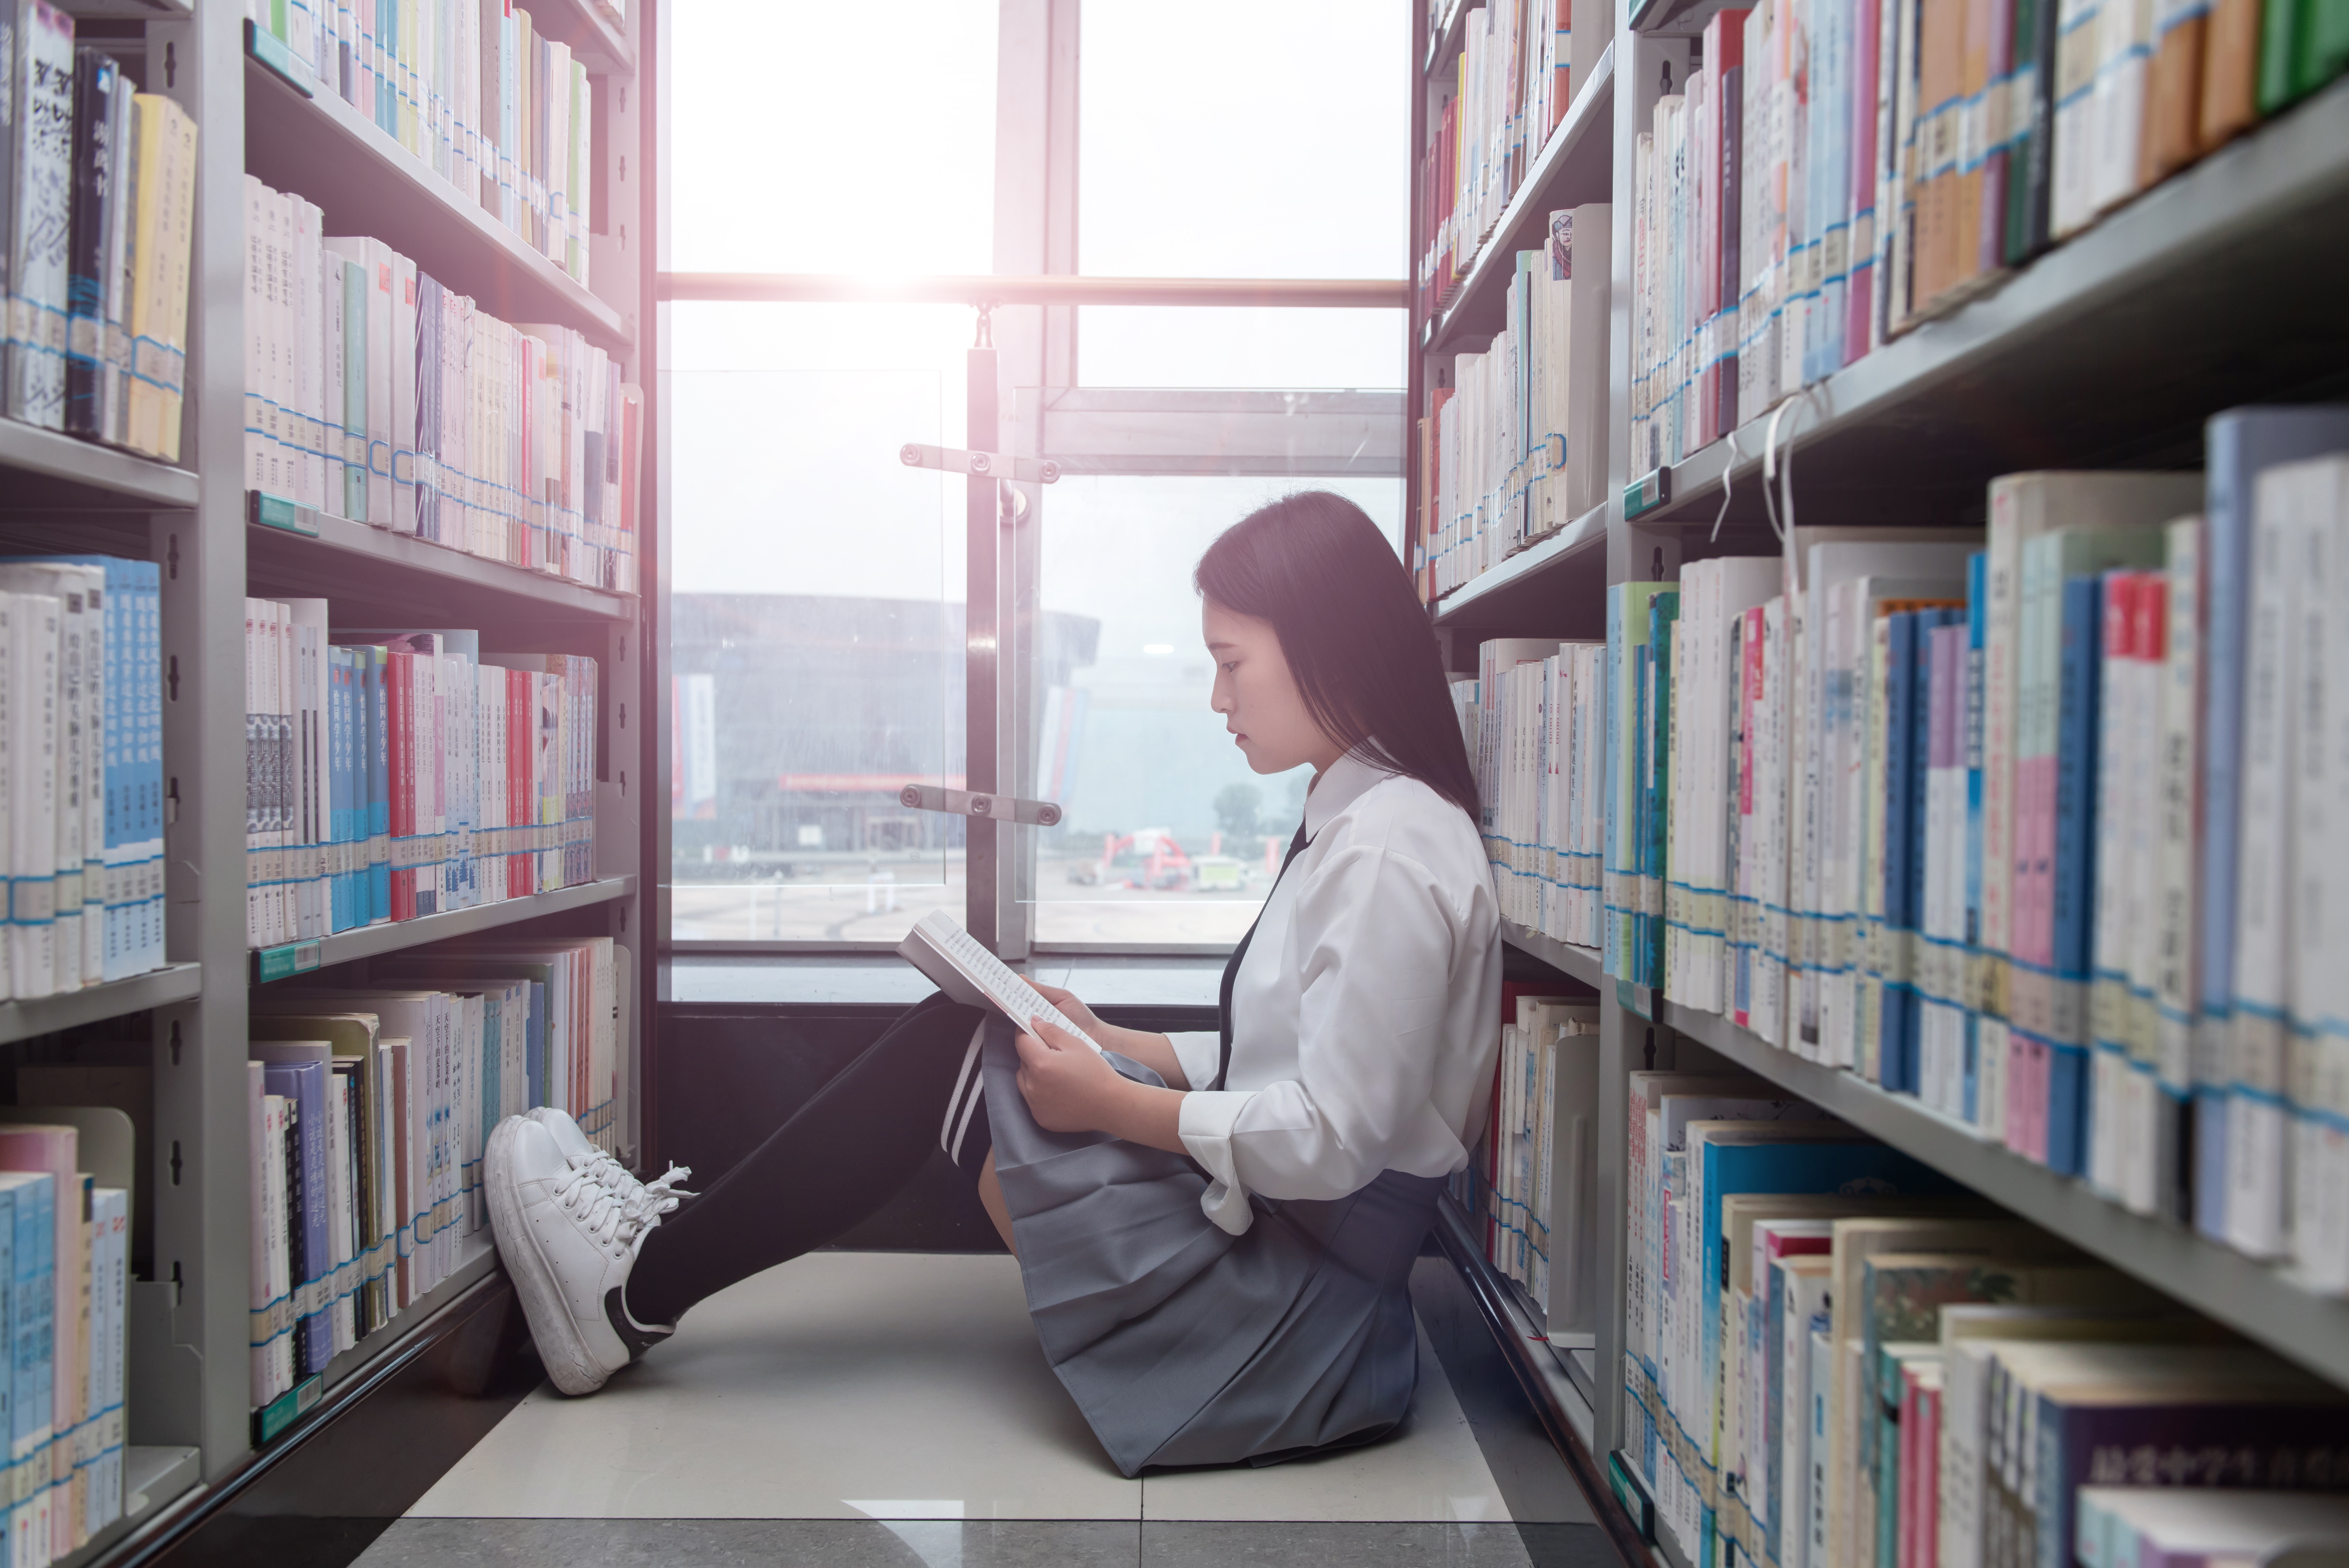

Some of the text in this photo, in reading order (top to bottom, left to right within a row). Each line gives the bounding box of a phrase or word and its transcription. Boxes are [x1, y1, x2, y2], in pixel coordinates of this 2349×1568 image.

[477, 381, 483, 403] 口味
[495, 387, 500, 409] 口味
[308, 1113, 319, 1228] 小说是灵魂的逆光
[315, 1111, 327, 1223] 小说是灵魂的逆光
